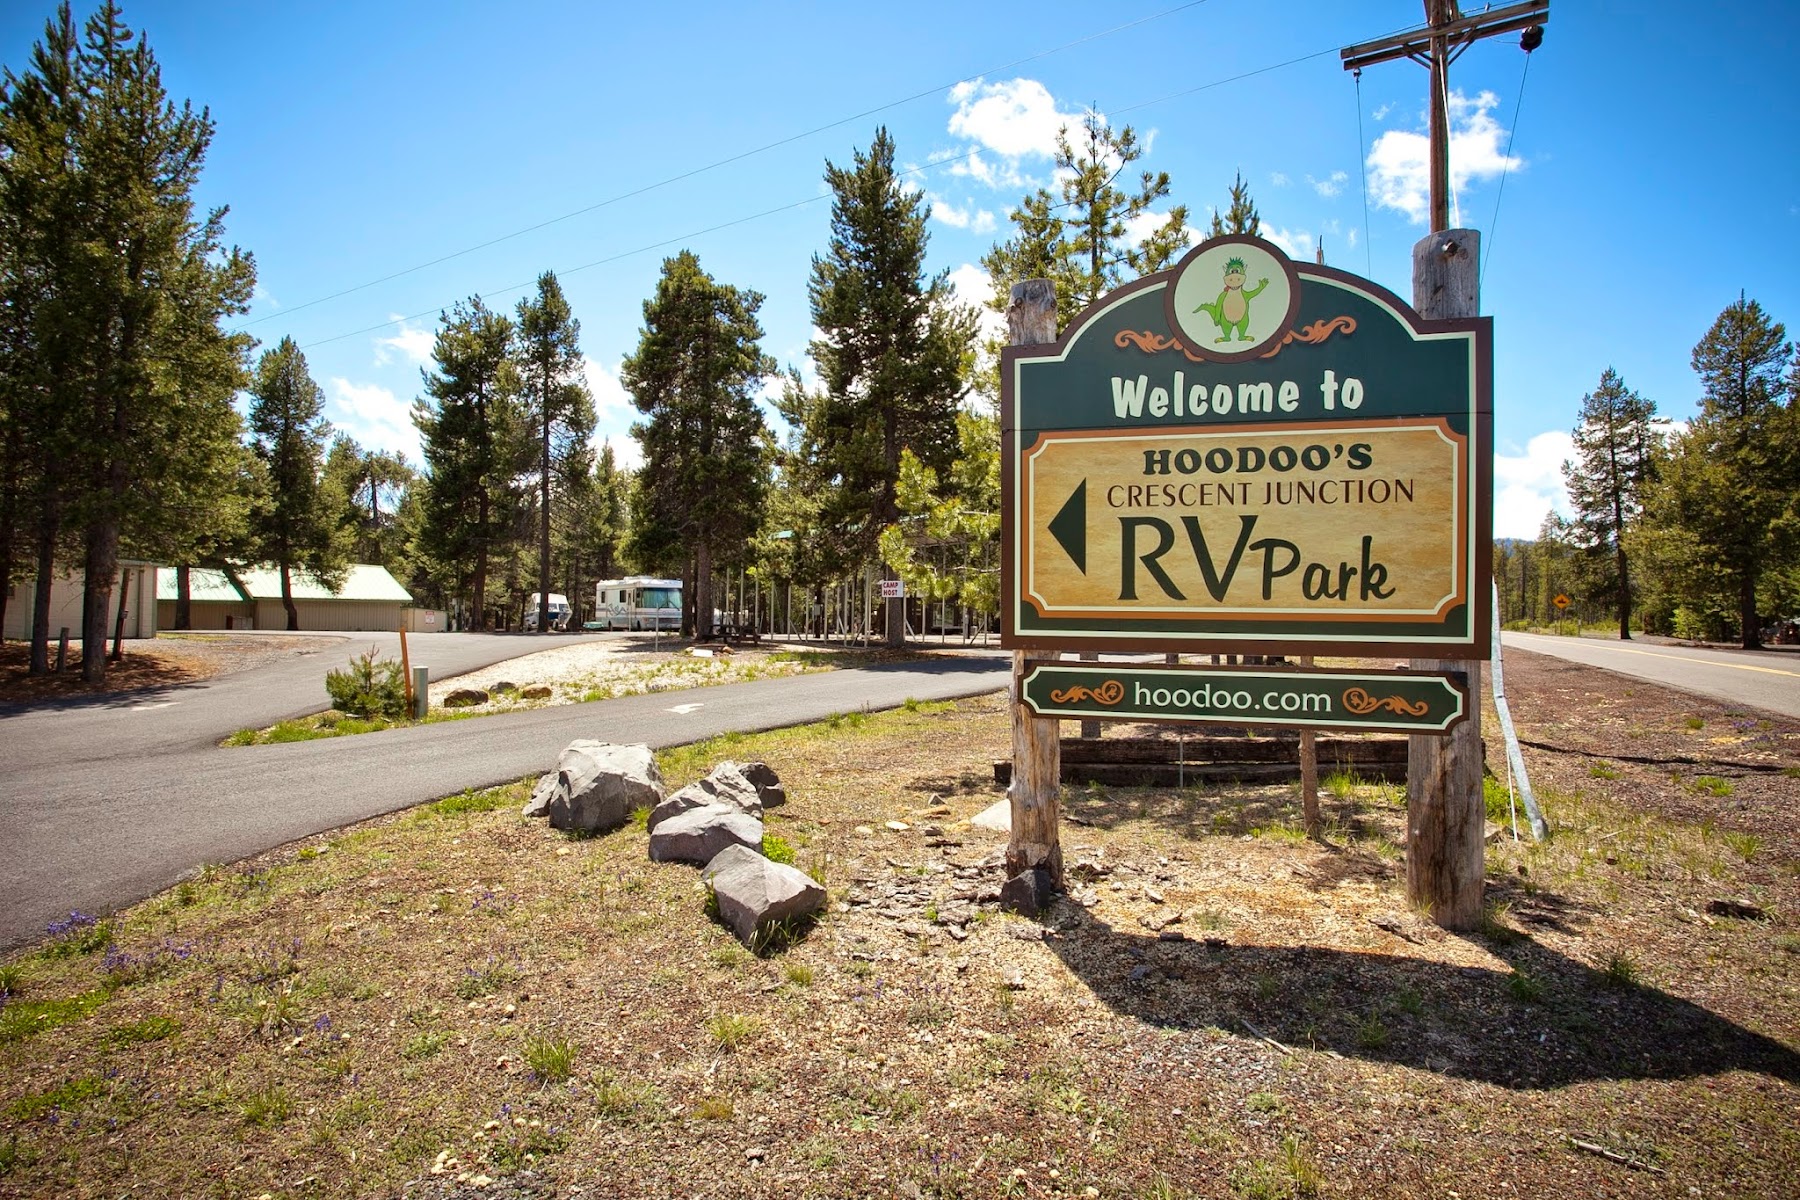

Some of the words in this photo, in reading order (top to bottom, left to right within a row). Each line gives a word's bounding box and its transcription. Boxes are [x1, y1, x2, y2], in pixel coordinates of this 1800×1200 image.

[1111, 371, 1300, 418] Welcome
[1320, 369, 1364, 411] to
[1143, 443, 1373, 476] HOODOO'S
[1107, 482, 1252, 508] CRESCENT
[1263, 479, 1414, 505] JUNCTION
[1118, 514, 1259, 603] RV
[1249, 535, 1396, 601] Park
[1135, 681, 1332, 712] hoodoo.com
